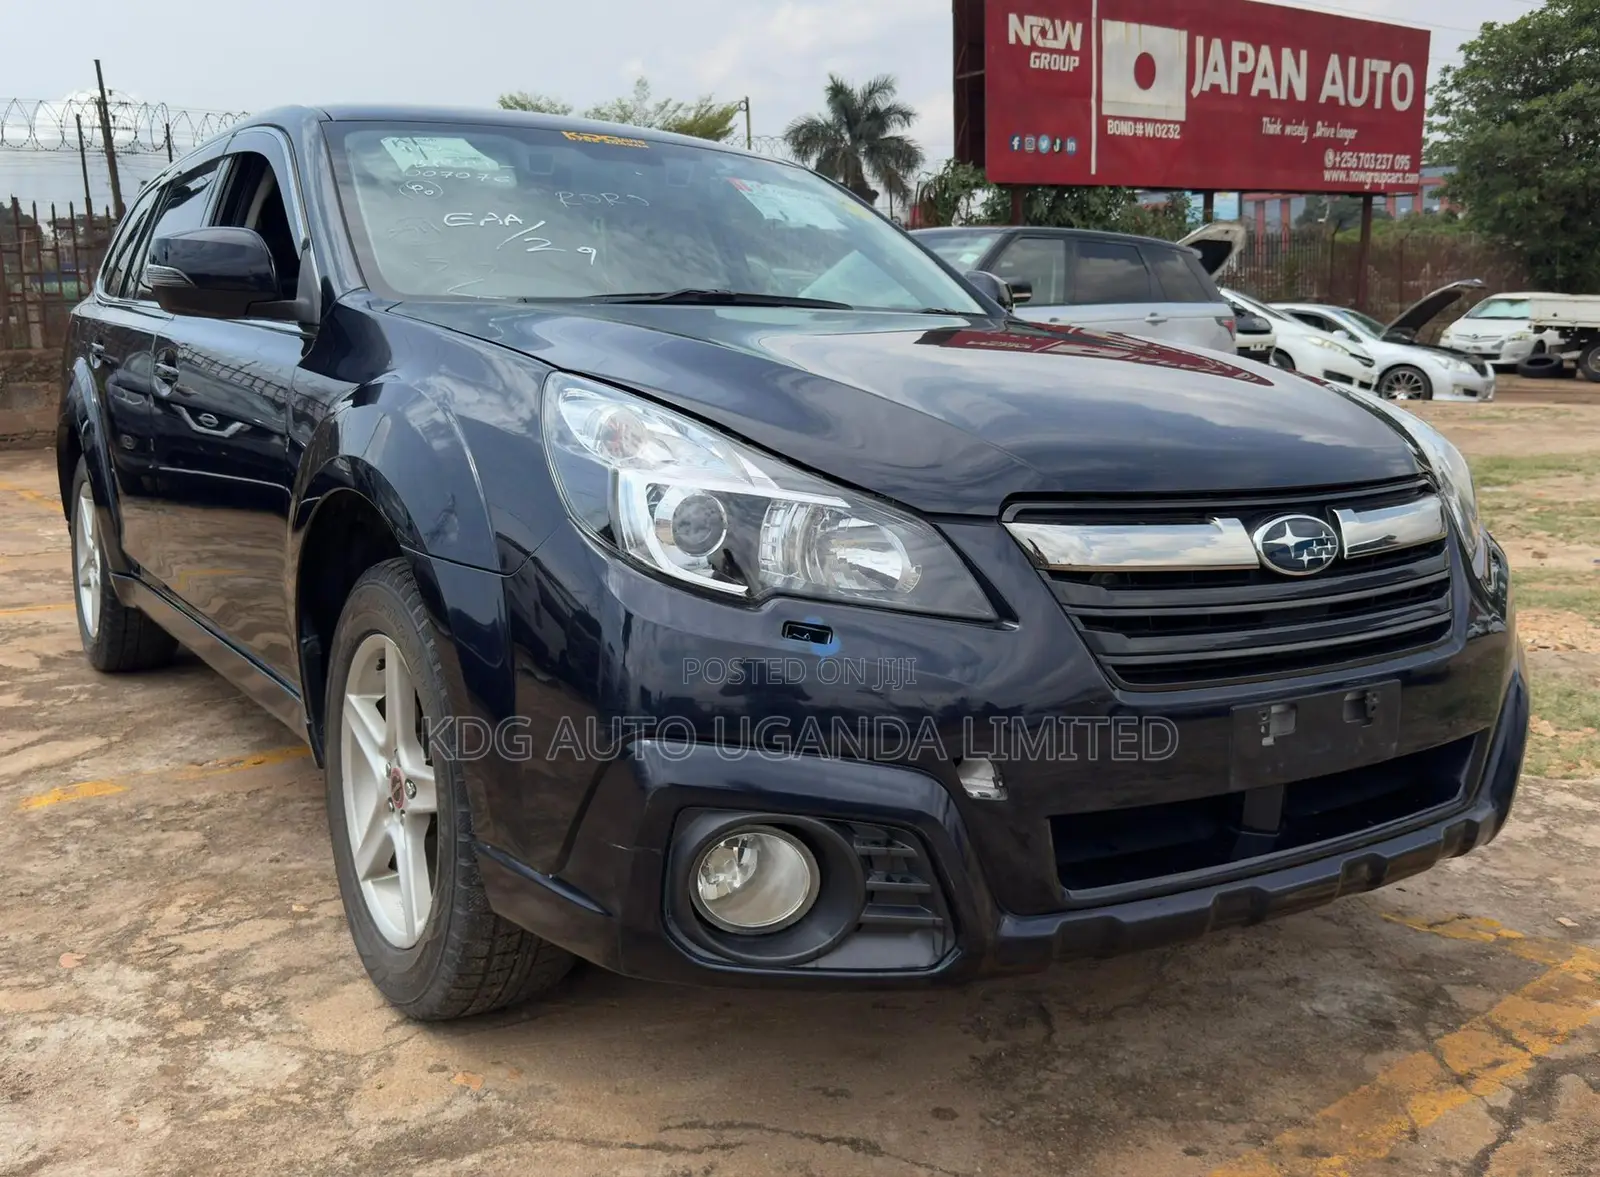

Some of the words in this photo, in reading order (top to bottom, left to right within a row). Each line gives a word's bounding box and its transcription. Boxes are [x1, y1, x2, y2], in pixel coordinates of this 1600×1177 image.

[1029, 52, 1080, 72] GROUP
[1191, 36, 1308, 102] JAPAN
[1318, 53, 1415, 112] AUTO
[1262, 116, 1283, 135] Think
[1285, 119, 1309, 144] wisely
[1323, 169, 1419, 190] www.nowgroupcars.com
